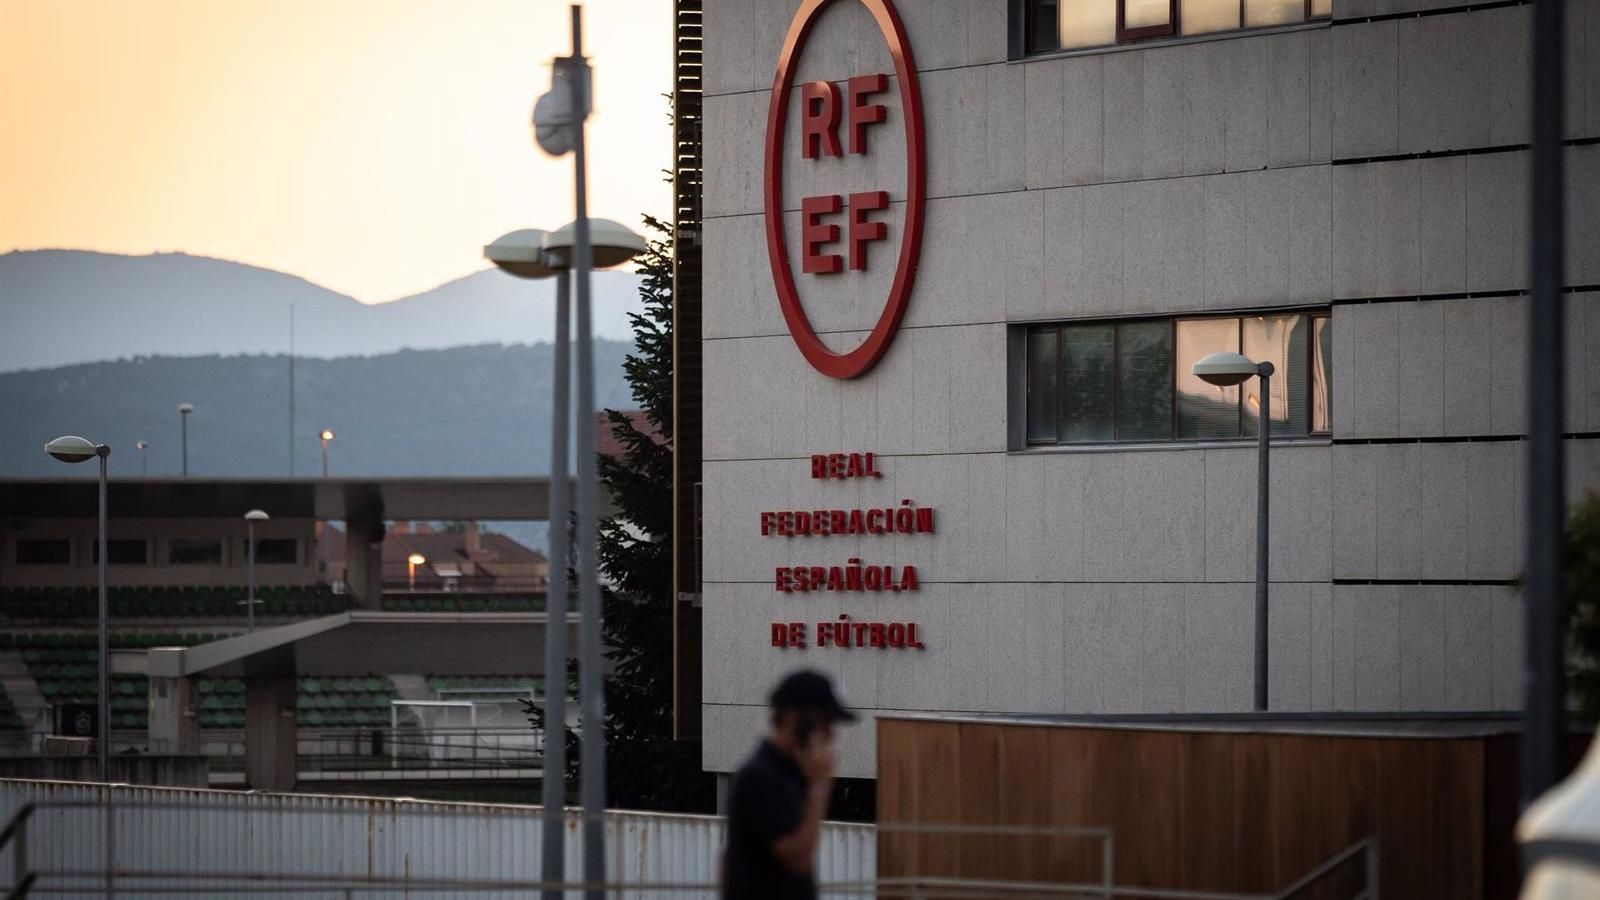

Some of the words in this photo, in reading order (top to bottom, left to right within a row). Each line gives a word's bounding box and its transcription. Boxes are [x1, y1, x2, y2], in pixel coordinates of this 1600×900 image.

[811, 453, 880, 479] REAL
[761, 499, 934, 536] FEDERACIÓN
[775, 558, 918, 592] ESPAÑOLA
[771, 623, 806, 648] DE
[817, 614, 924, 648] FÚTBOL
